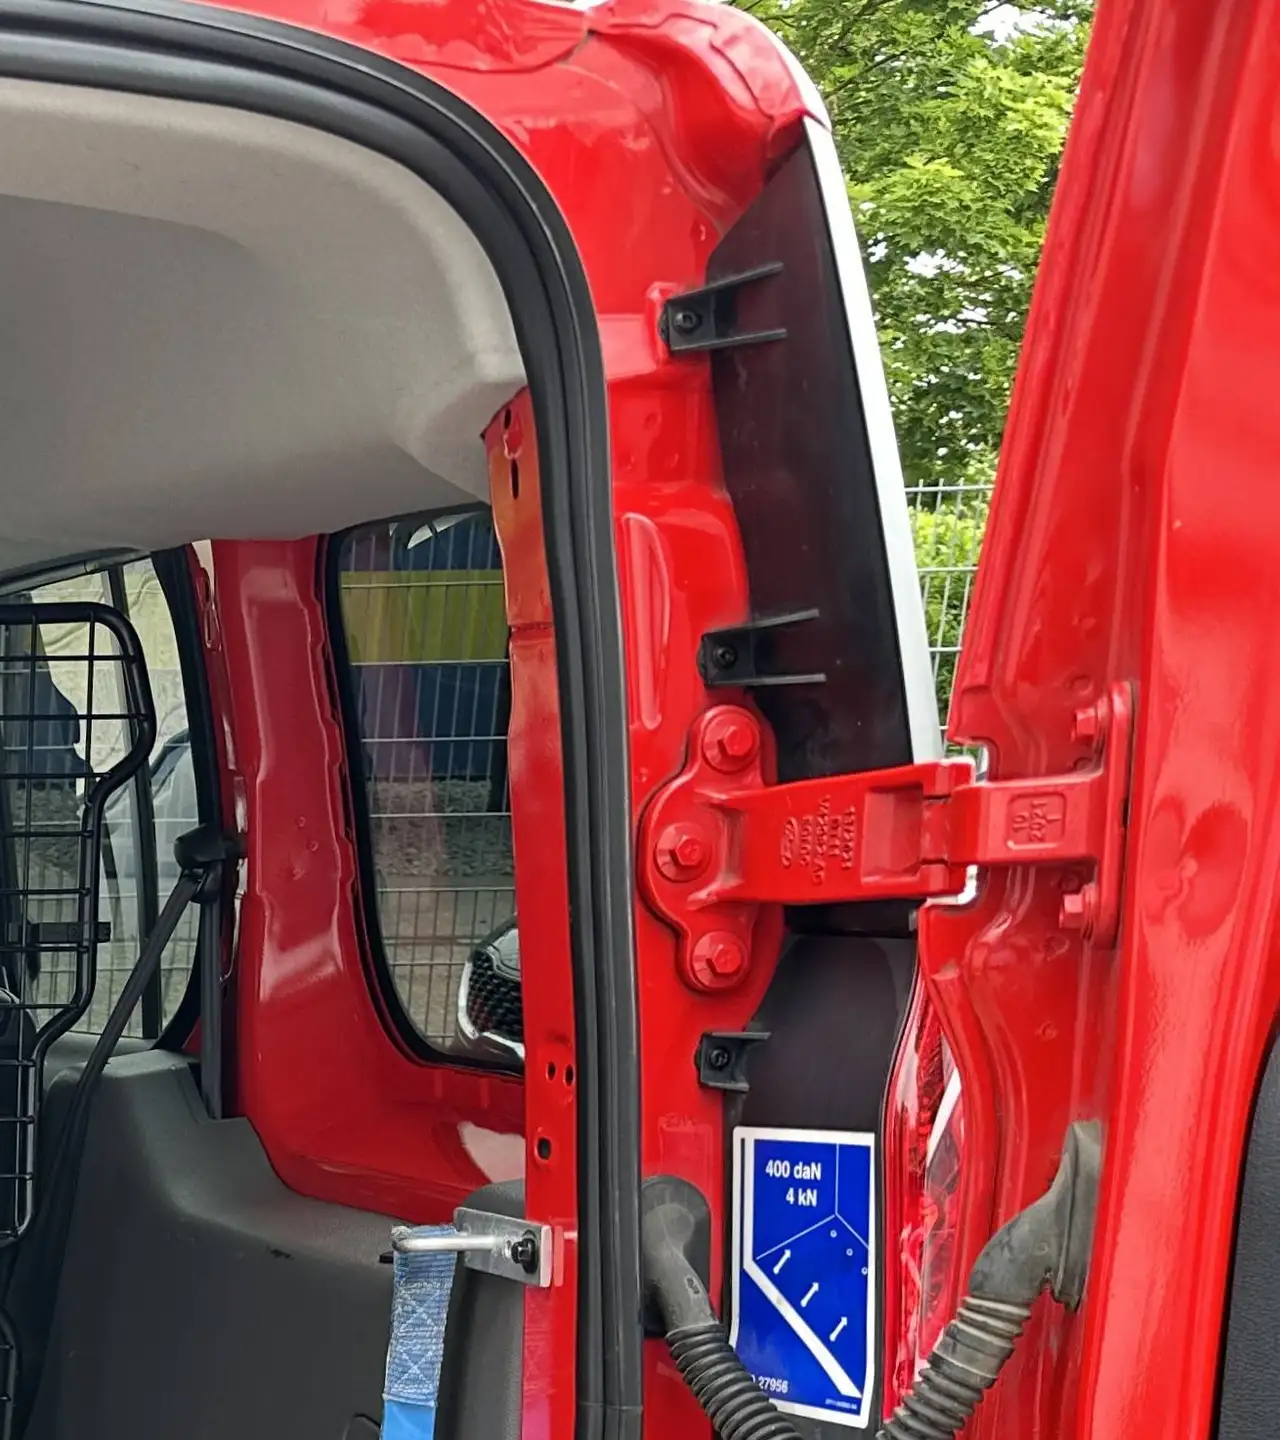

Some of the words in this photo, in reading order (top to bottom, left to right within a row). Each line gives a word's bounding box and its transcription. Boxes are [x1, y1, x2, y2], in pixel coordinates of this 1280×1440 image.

[1012, 812, 1028, 833] 10
[1029, 799, 1047, 842] 2021
[765, 1159, 790, 1178] 400
[793, 1161, 822, 1181] daN
[785, 1187, 795, 1205] 4
[798, 1188, 817, 1207] kN
[758, 1376, 789, 1394] 27956
